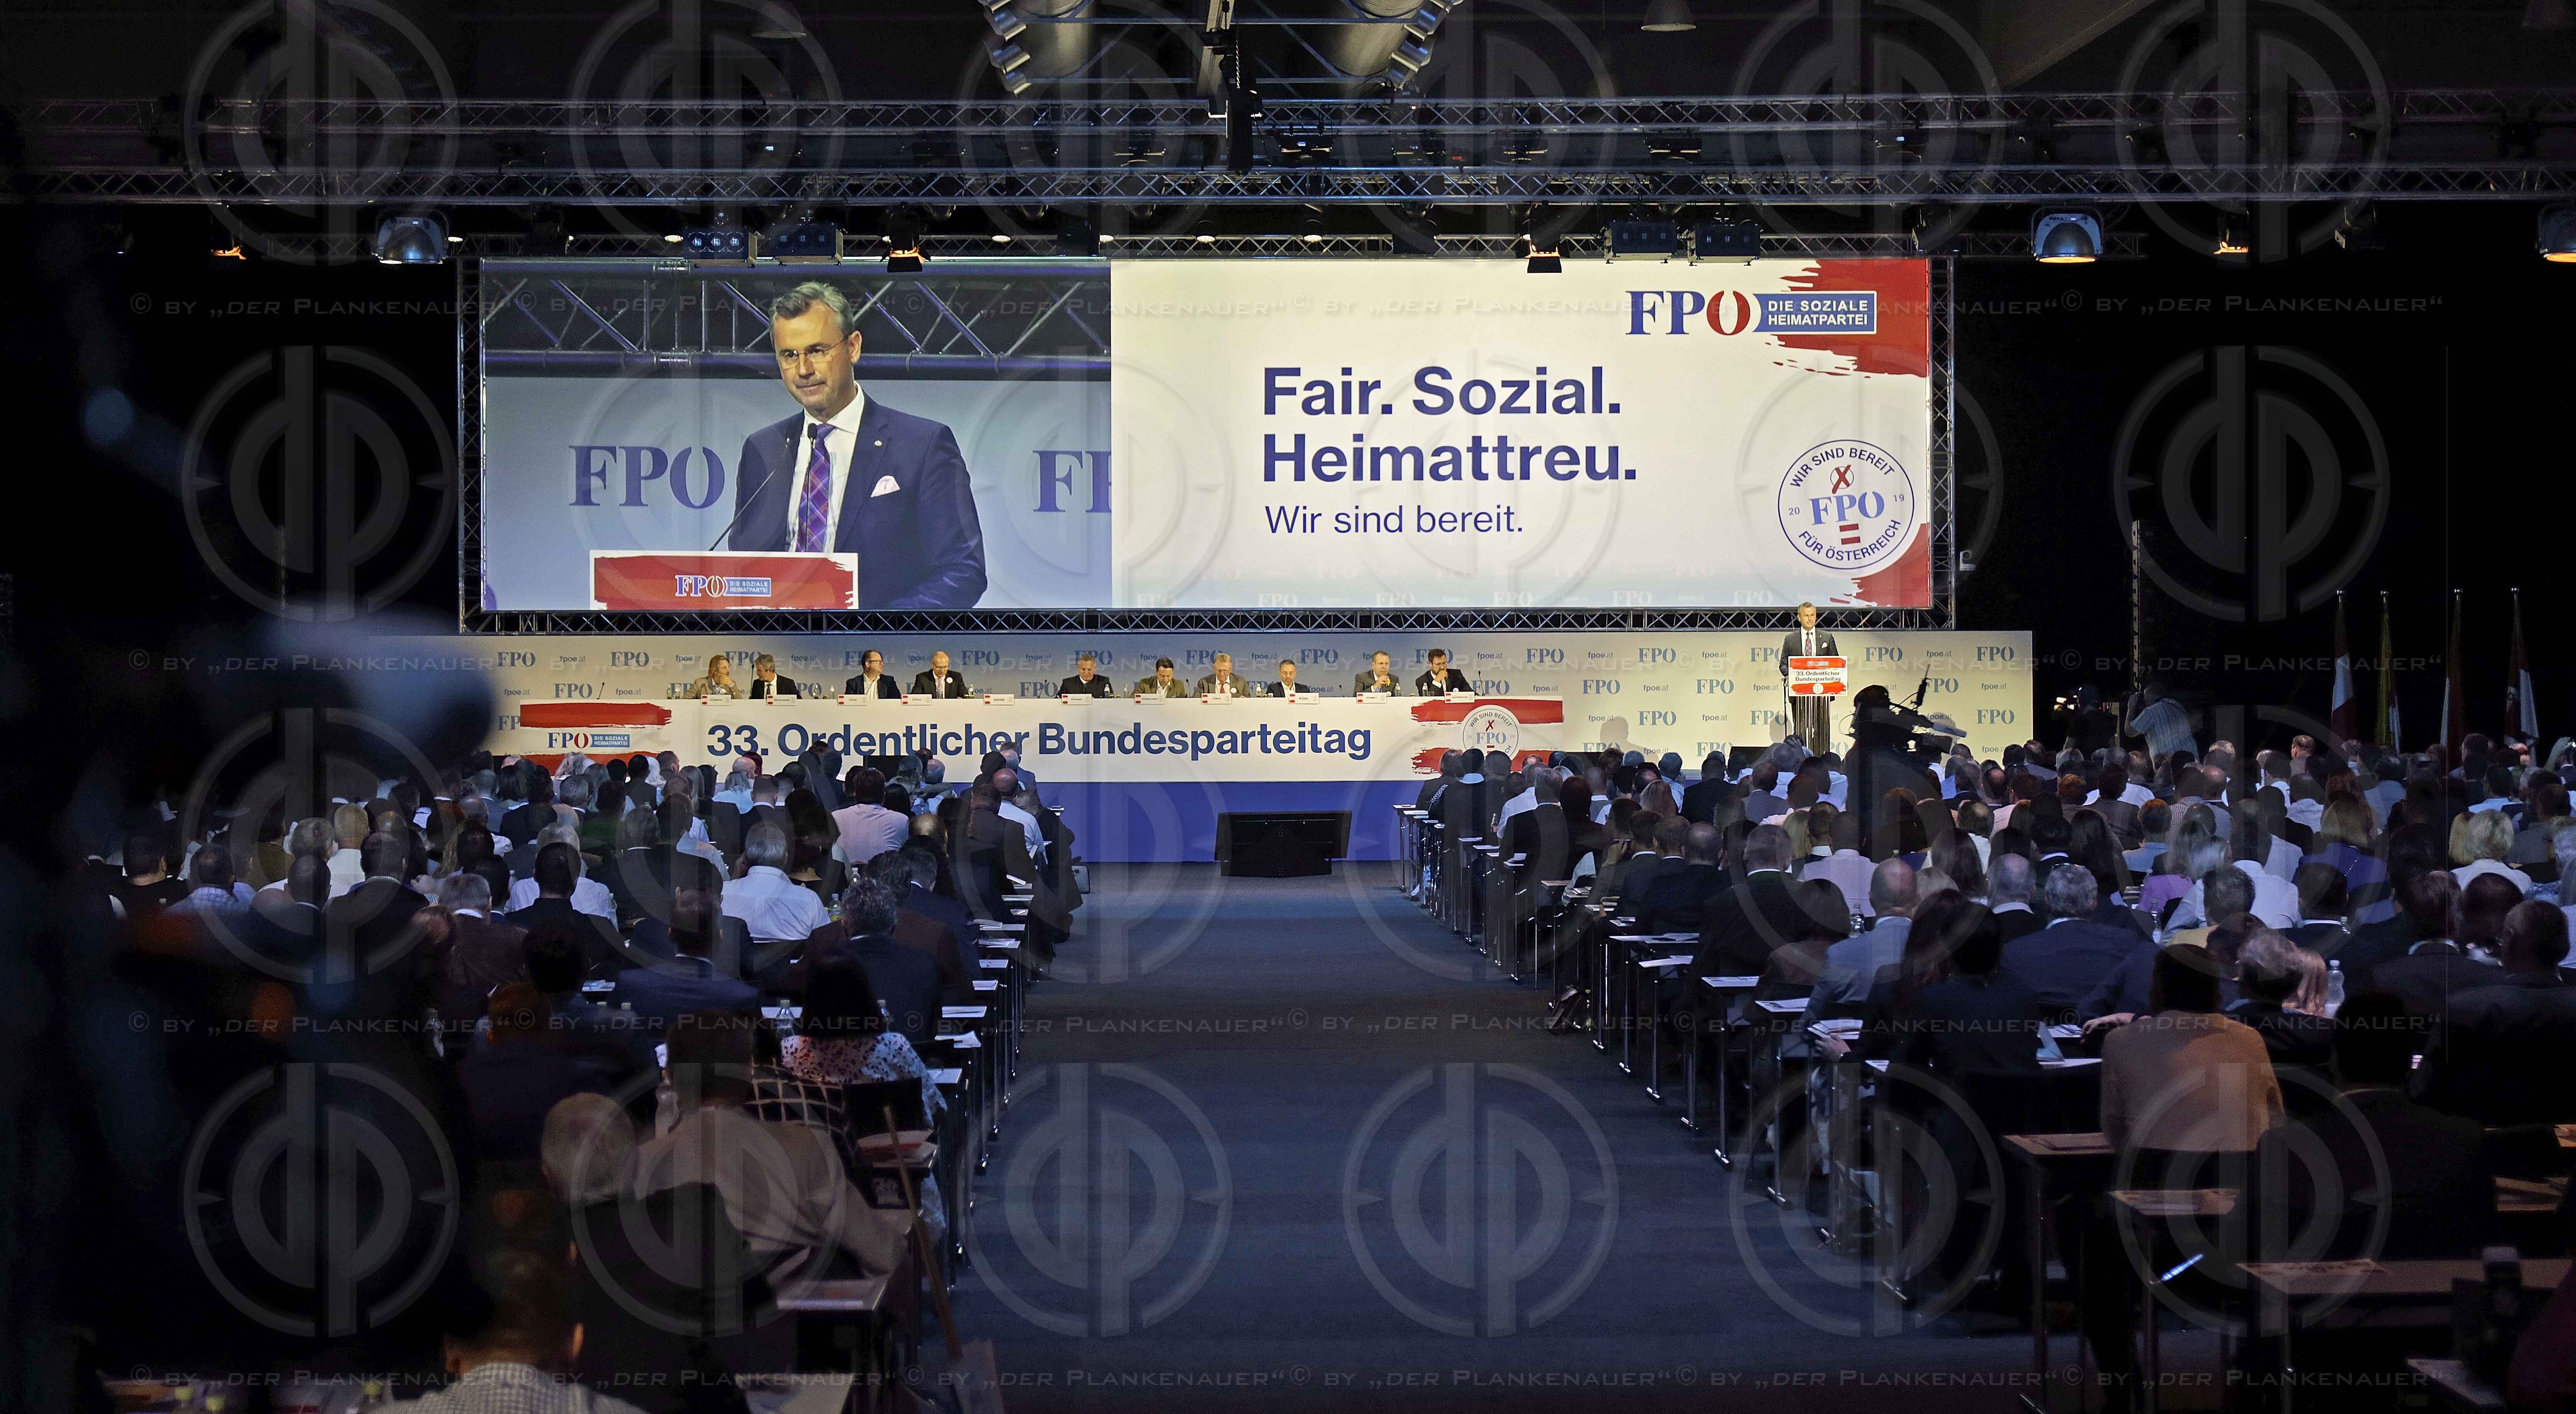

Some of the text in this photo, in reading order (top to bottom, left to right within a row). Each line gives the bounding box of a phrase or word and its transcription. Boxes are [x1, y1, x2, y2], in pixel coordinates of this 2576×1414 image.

[1769, 300, 1867, 311] DIE SOZIALE
[1769, 314, 1867, 325] HEIMATPARTEI
[1264, 366, 1620, 416] Fair. Sozial.
[1264, 433, 1636, 482] Heimattreu.
[1790, 448, 1895, 487] WIR SIND BEREIT
[1265, 504, 1523, 533] Wir sind bereit.
[1798, 519, 1901, 560] FÜR ÖSTERREICH
[1026, 654, 1051, 664] fpoe.at
[616, 689, 641, 697] fpoe.at
[1469, 717, 1479, 727] WIR
[1494, 713, 1512, 727] BEREIT
[1927, 713, 1951, 721] fpoe.at
[707, 724, 768, 756] 33.
[1038, 722, 1371, 761] Bundesparteitag
